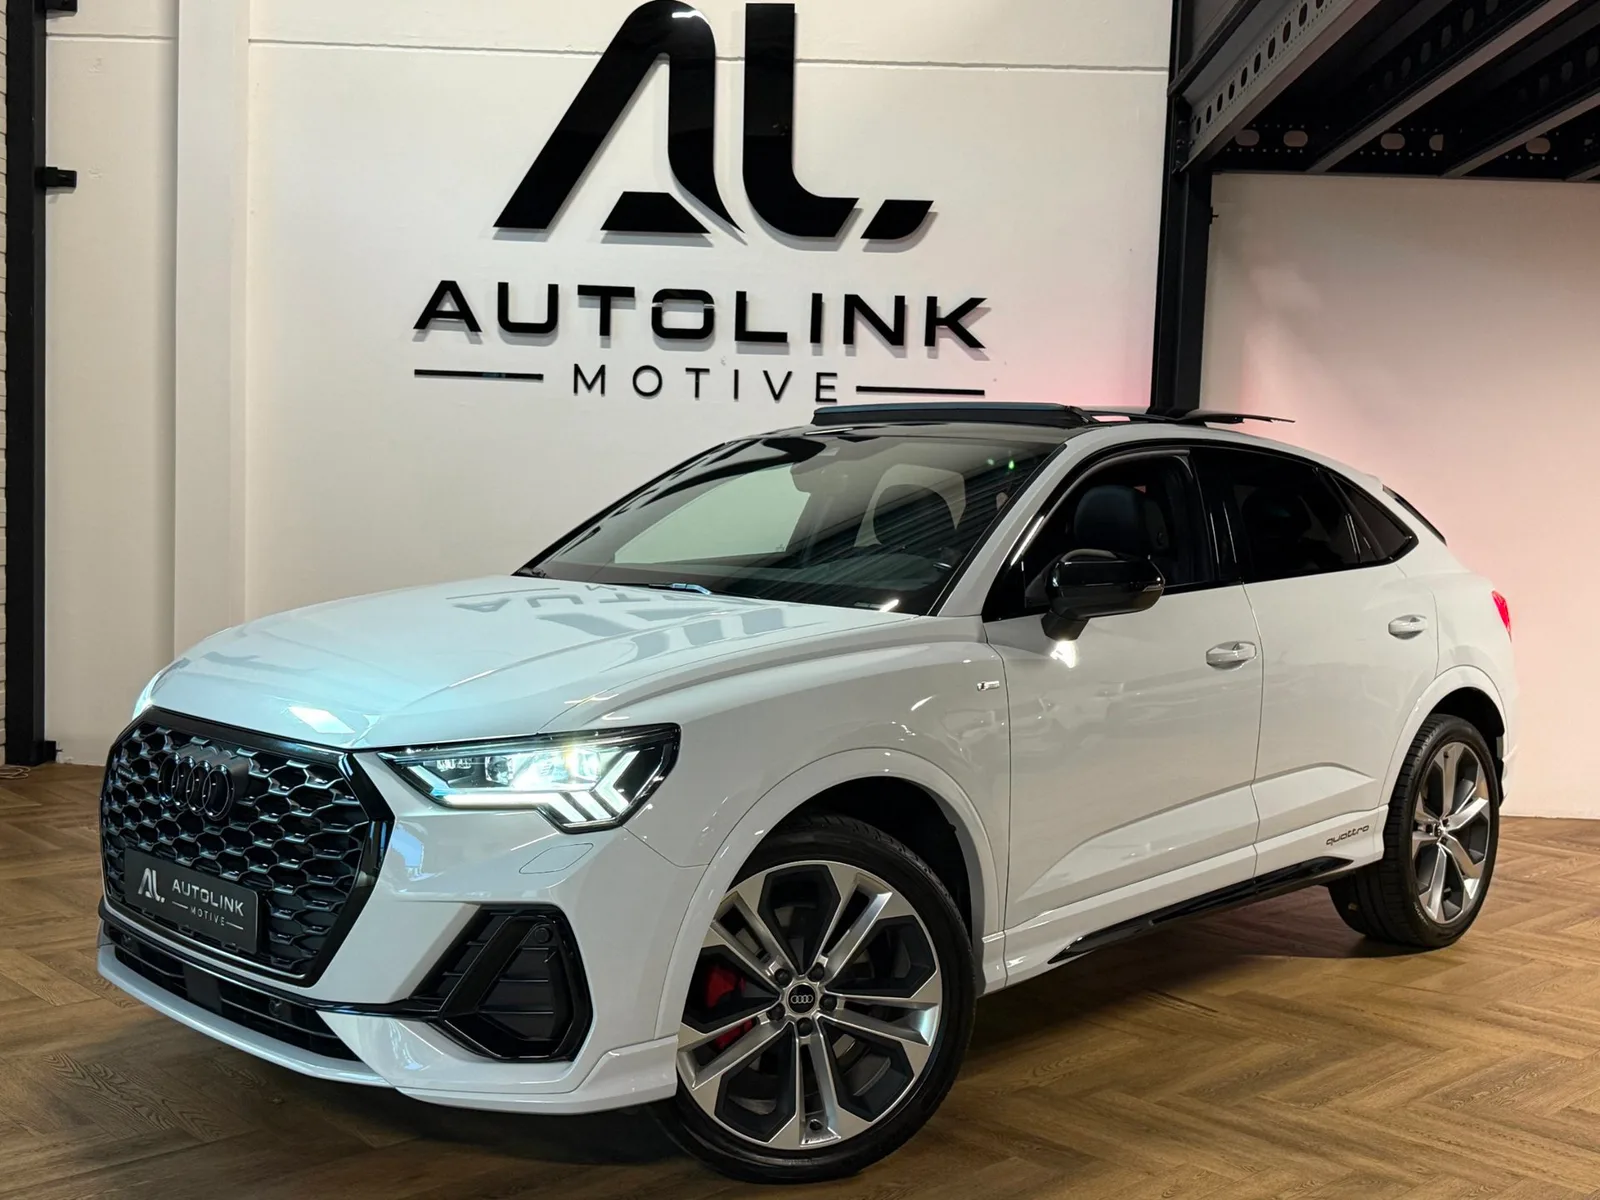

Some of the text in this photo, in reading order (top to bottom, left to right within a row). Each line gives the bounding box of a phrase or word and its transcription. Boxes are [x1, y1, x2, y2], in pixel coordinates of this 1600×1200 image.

[413, 280, 987, 349] AUTOLINK
[573, 363, 839, 404] MOTIVE
[172, 879, 244, 917] AUTOLINK
[190, 906, 225, 926] MOTIVE
